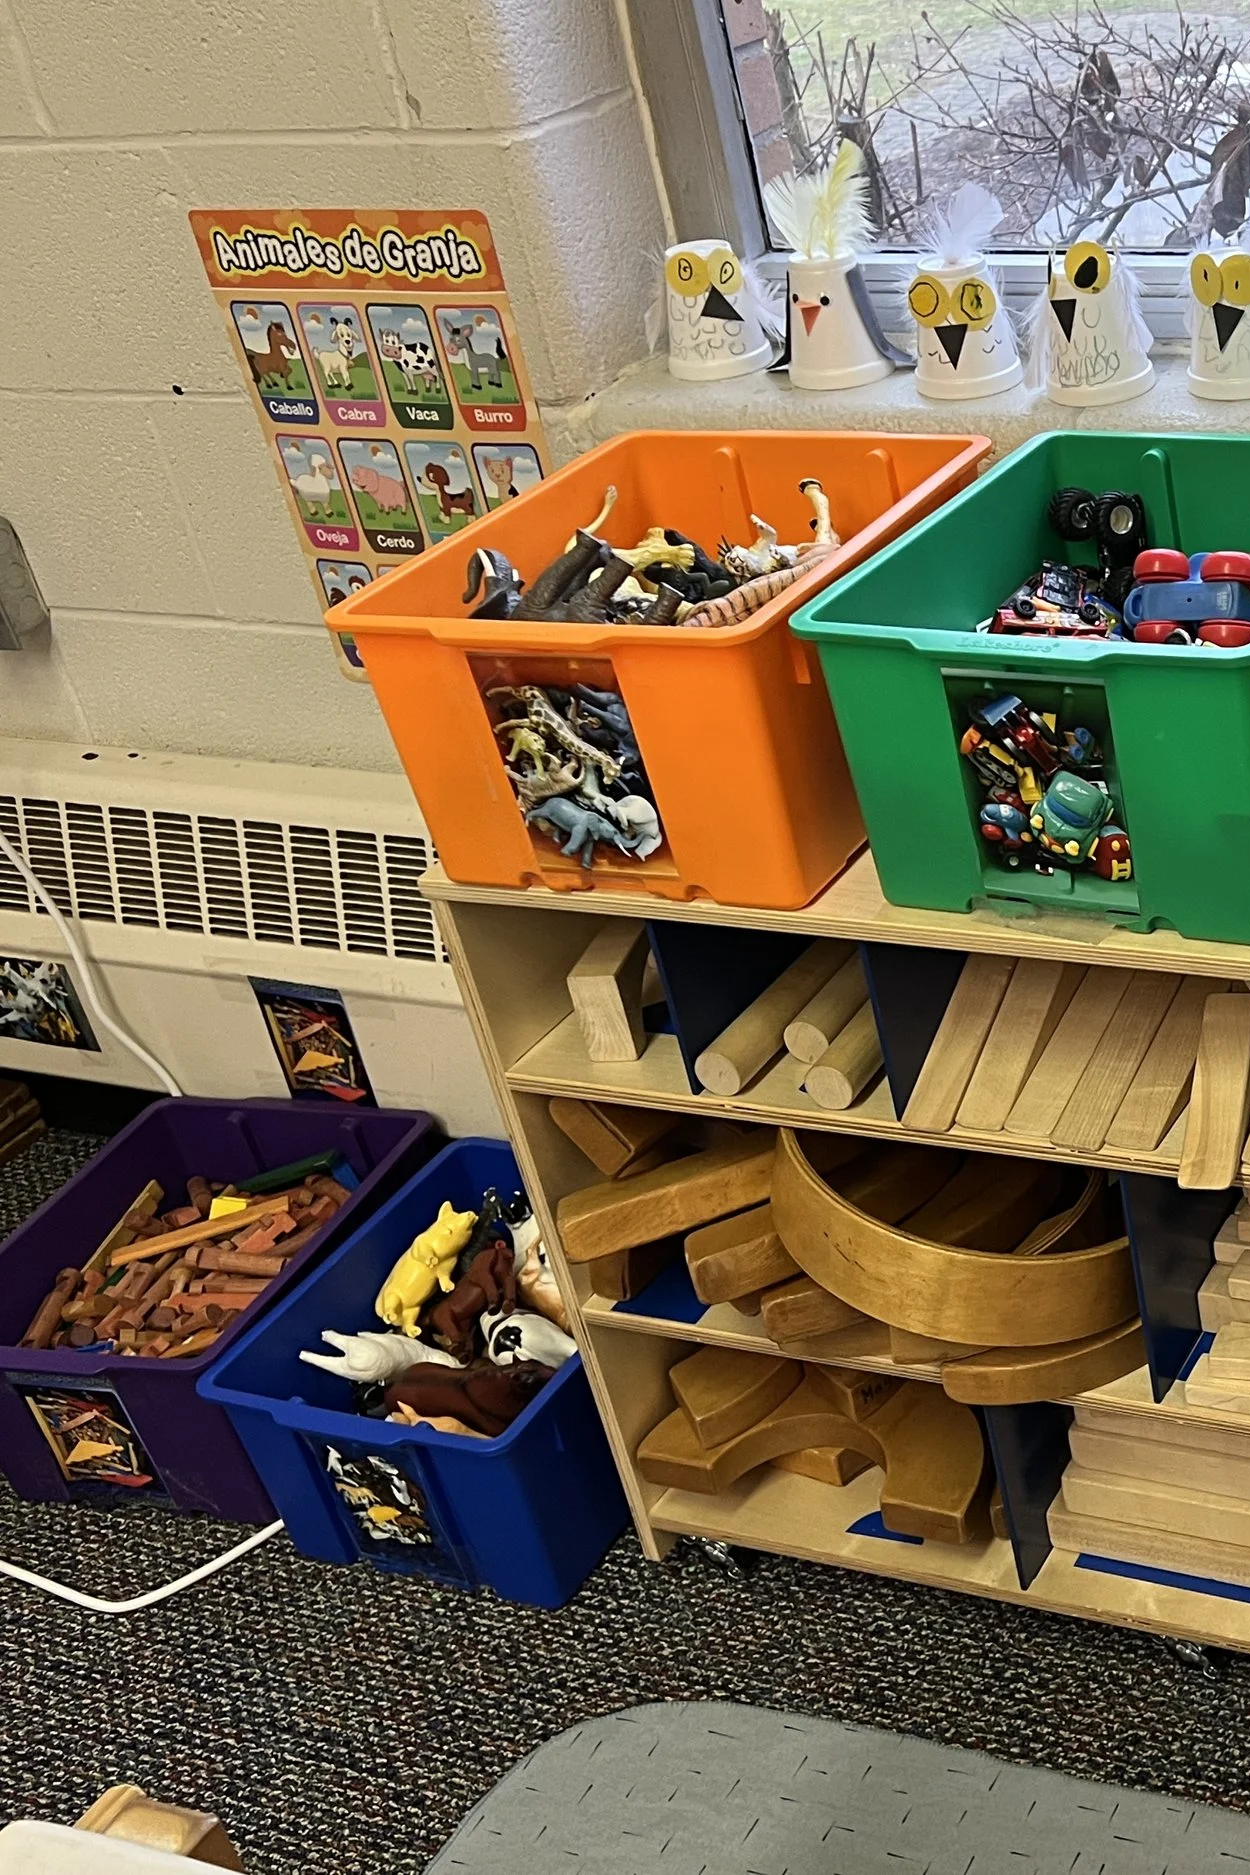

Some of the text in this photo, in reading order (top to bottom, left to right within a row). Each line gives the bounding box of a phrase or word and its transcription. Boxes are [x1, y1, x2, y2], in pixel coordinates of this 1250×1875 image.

[214, 226, 481, 278] Animales de Granja
[269, 401, 314, 417] Caballo
[337, 407, 377, 421] Cabra
[406, 406, 440, 421] Vaca
[474, 409, 514, 423] Burro
[316, 528, 349, 546] Oveja
[377, 534, 415, 549] Cerdo
